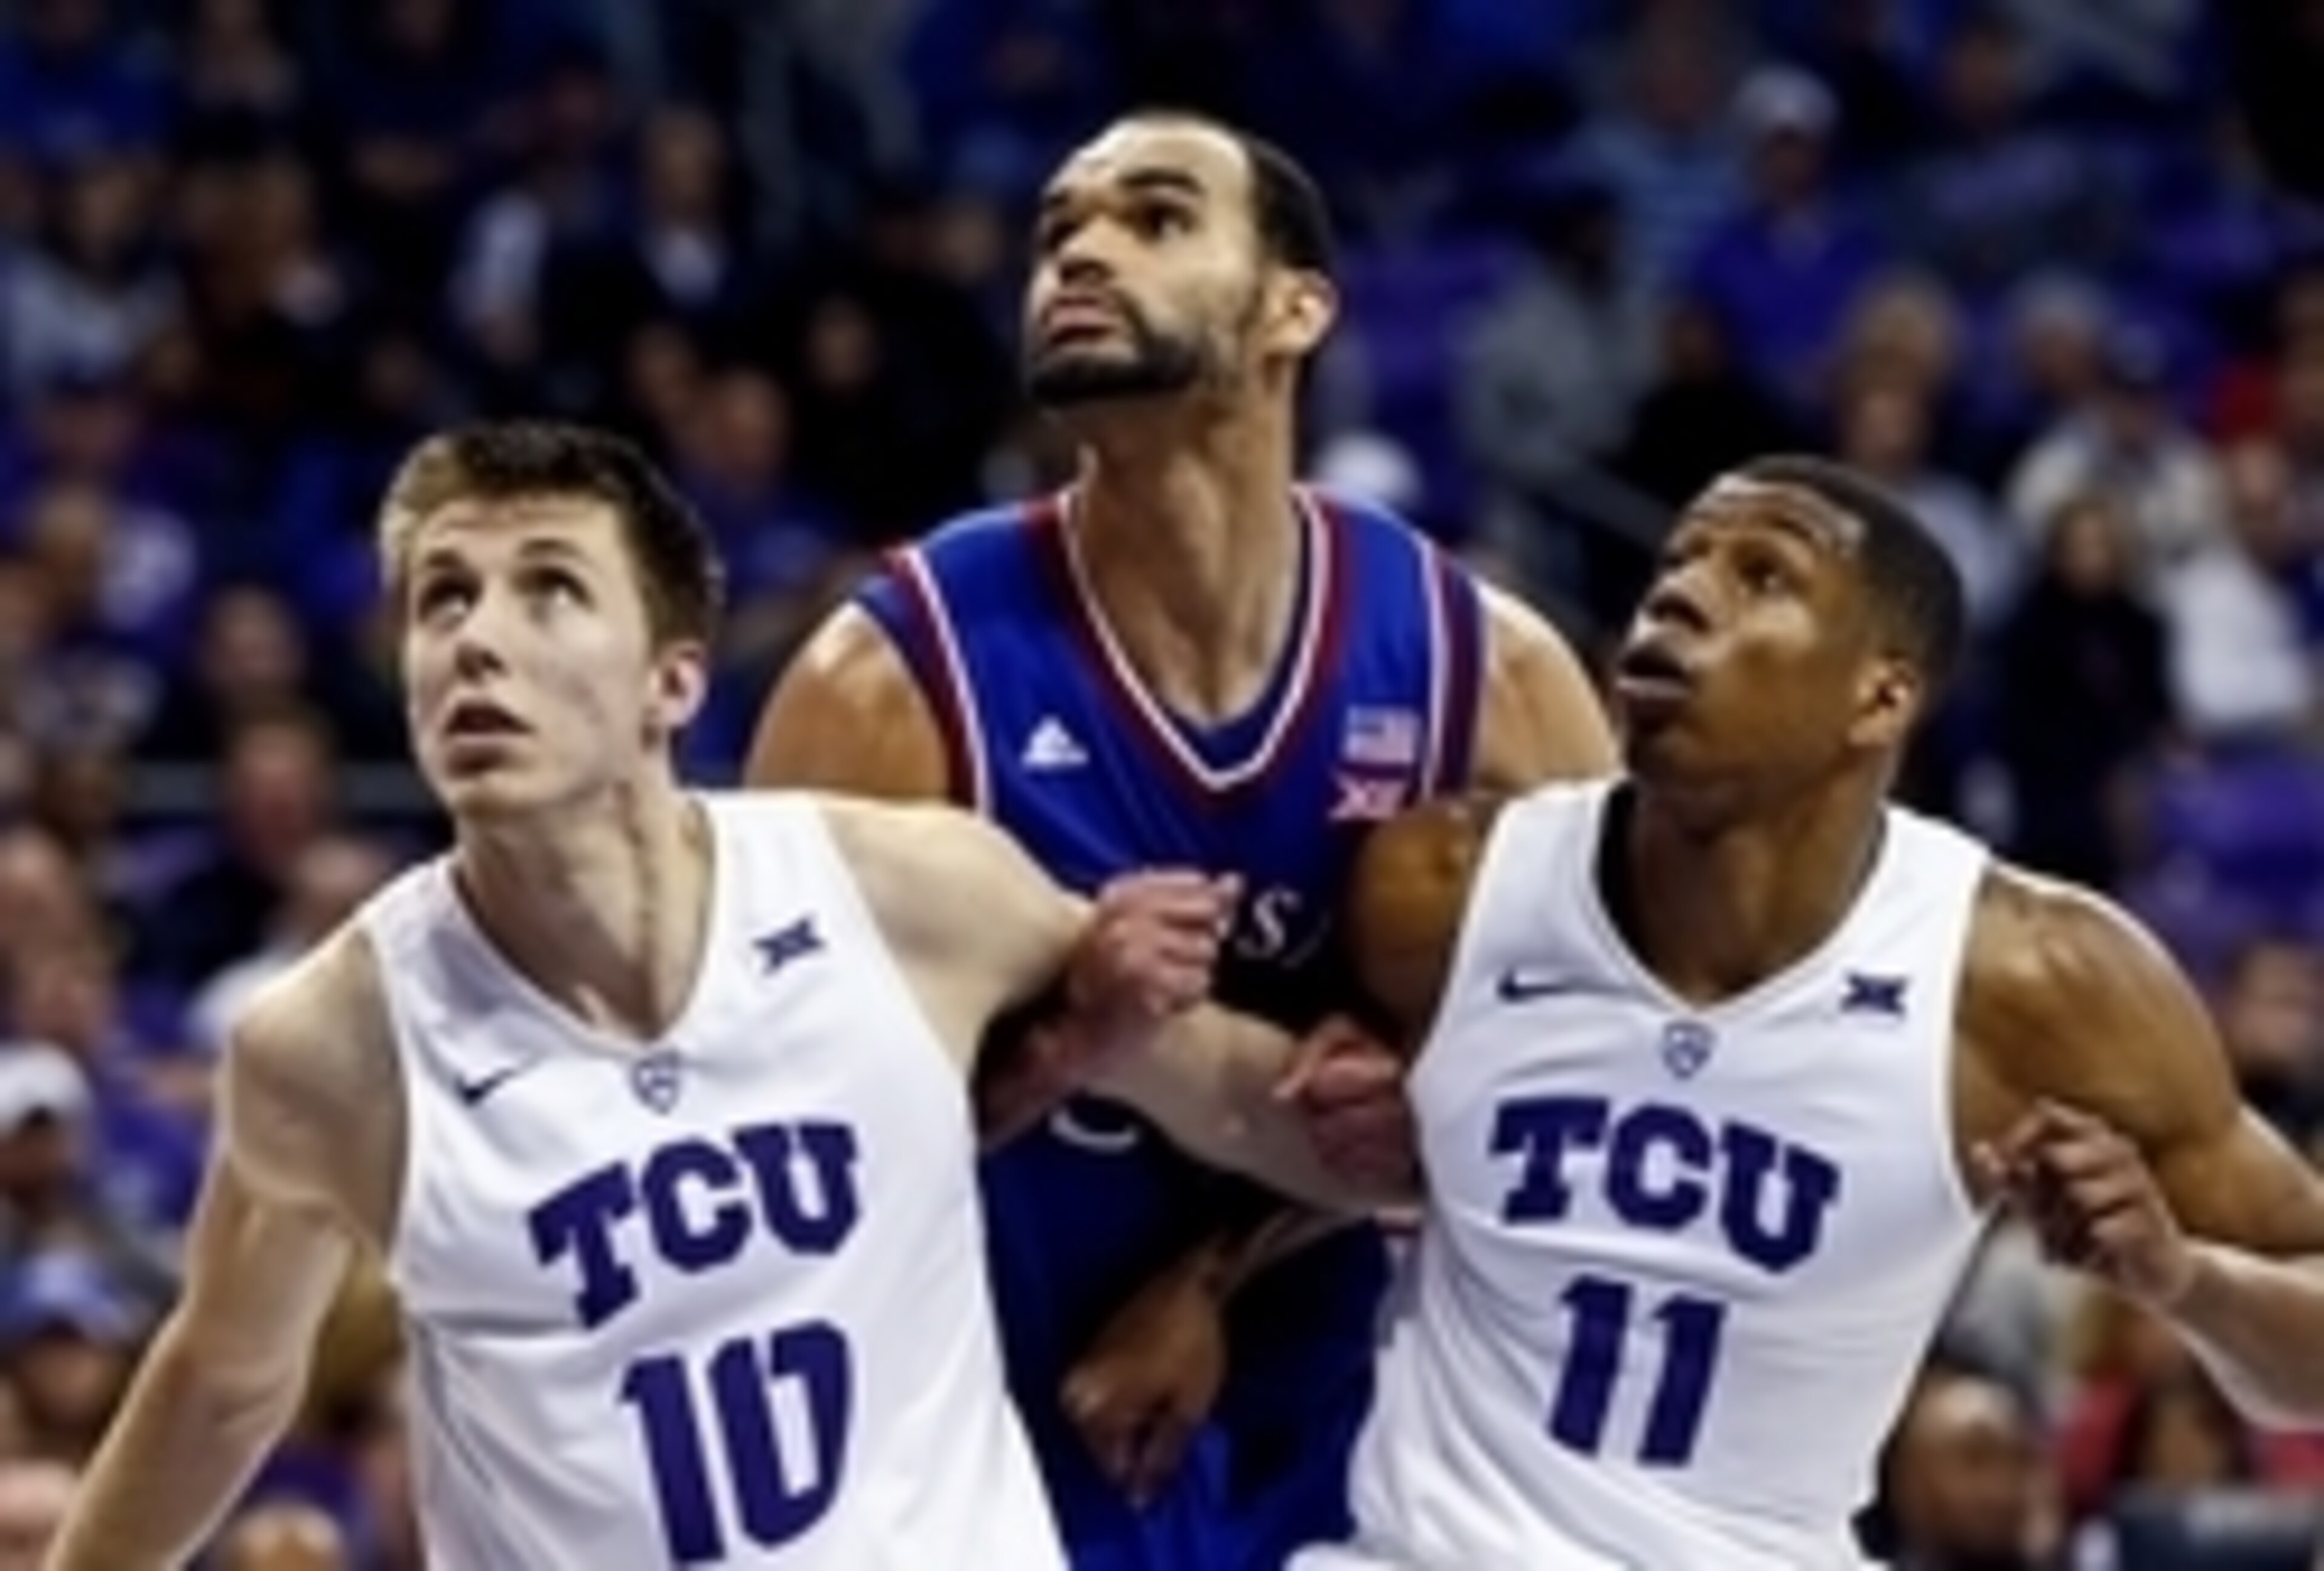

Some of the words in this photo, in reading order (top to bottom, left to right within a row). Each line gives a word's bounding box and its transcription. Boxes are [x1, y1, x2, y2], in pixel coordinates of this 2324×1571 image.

[526, 1121, 859, 1331] TCU
[1487, 1094, 1841, 1274] TCU
[619, 1320, 852, 1564] 10
[1547, 1273, 1727, 1469] 11
